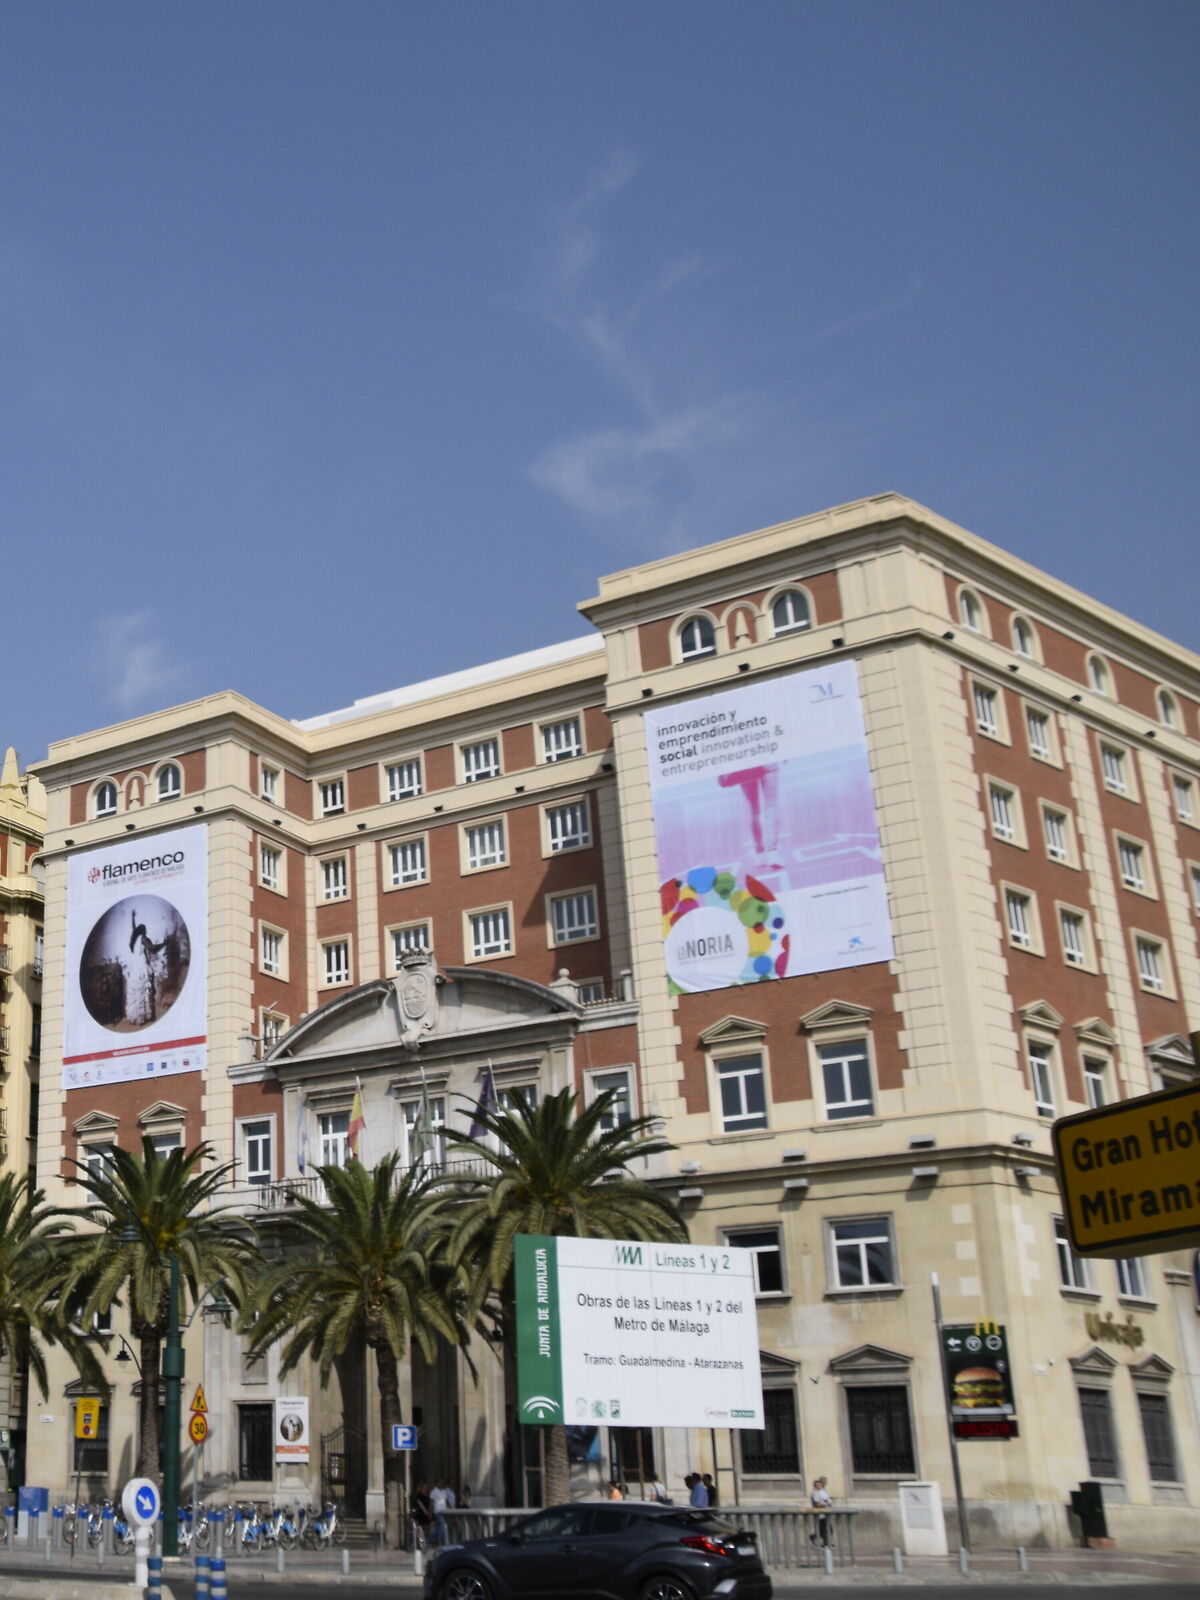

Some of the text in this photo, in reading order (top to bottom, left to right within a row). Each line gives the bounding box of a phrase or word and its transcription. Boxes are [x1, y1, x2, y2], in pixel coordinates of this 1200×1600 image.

[657, 710, 737, 737] innovación y
[659, 716, 768, 750] emprendimiento
[660, 724, 784, 764] social innovation &
[661, 741, 779, 777] entrepreneurship
[102, 851, 184, 880] flamenco
[686, 934, 734, 958] NORIA
[1072, 1135, 1142, 1171] Gran
[700, 1253, 706, 1268] 1
[710, 1258, 718, 1273] y
[723, 1254, 731, 1269] 2
[538, 1308, 549, 1320] DE
[577, 1293, 612, 1308] Obras
[616, 1296, 630, 1309] de
[634, 1296, 650, 1310] las
[697, 1299, 702, 1312] 1
[706, 1303, 713, 1315] y
[716, 1300, 723, 1313] 2
[726, 1301, 743, 1314] del
[614, 1317, 647, 1331] Metro
[651, 1319, 665, 1332] de
[538, 1325, 551, 1358] JUNTA
[584, 1353, 616, 1366] Tramo:
[619, 1355, 686, 1368] Guadalmedina
[694, 1357, 744, 1370] Atarazanas
[194, 1422, 204, 1435] 30
[397, 1428, 411, 1447] P
